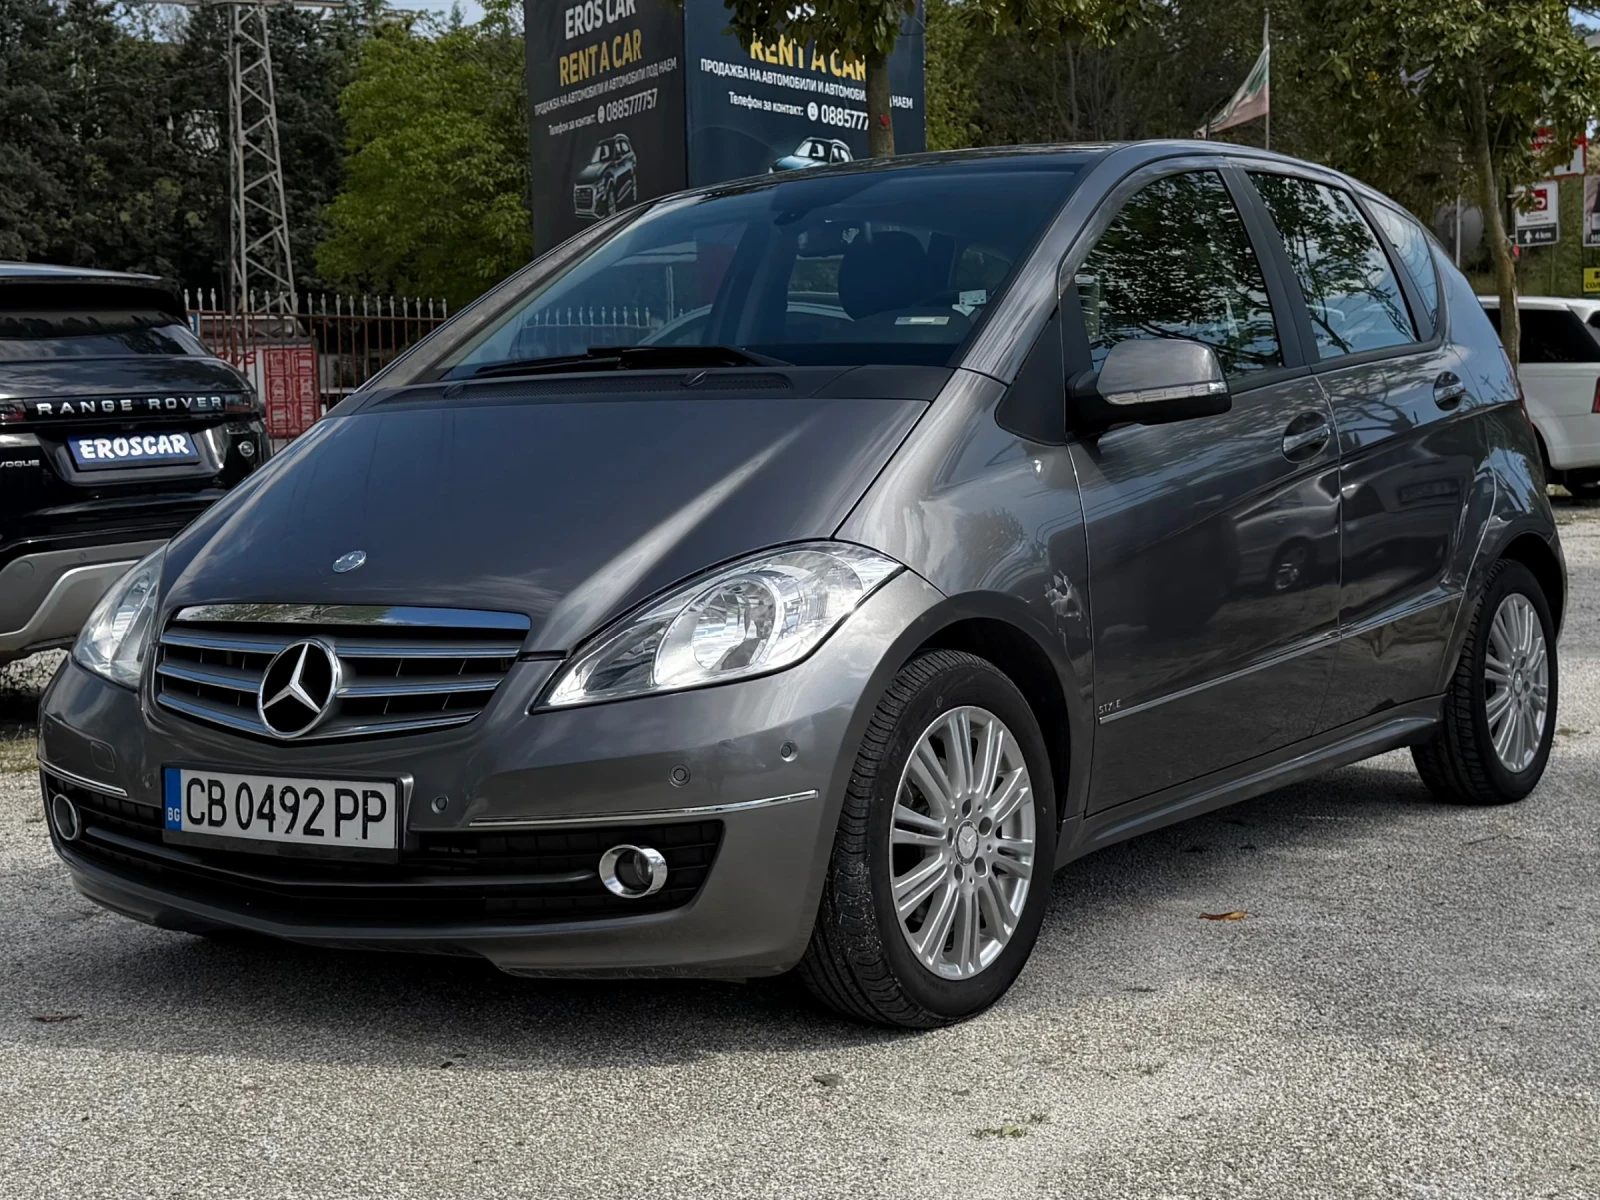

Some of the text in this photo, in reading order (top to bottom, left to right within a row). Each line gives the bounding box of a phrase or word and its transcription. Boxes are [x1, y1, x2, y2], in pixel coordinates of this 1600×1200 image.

[565, 0, 636, 40] EROS CAR
[559, 28, 643, 87] RENT A CAR
[659, 56, 678, 74] НАЕМ
[700, 58, 749, 80] ПРОДАЖБА
[750, 68, 762, 82] НА
[762, 70, 817, 92] АВТОМОБИЛИ
[818, 81, 824, 93] И
[824, 82, 867, 102] АВТОМОБИ
[606, 87, 658, 122] 0885777757
[728, 91, 869, 131] Телефон за контакт: 0885777
[892, 95, 913, 109] НАЕМ
[36, 396, 223, 416] RANGE ROVER
[78, 433, 190, 460] EROSCAR
[1098, 699, 1121, 714] STYE
[167, 806, 181, 822] BG
[186, 777, 387, 840] CB 0492 PP
